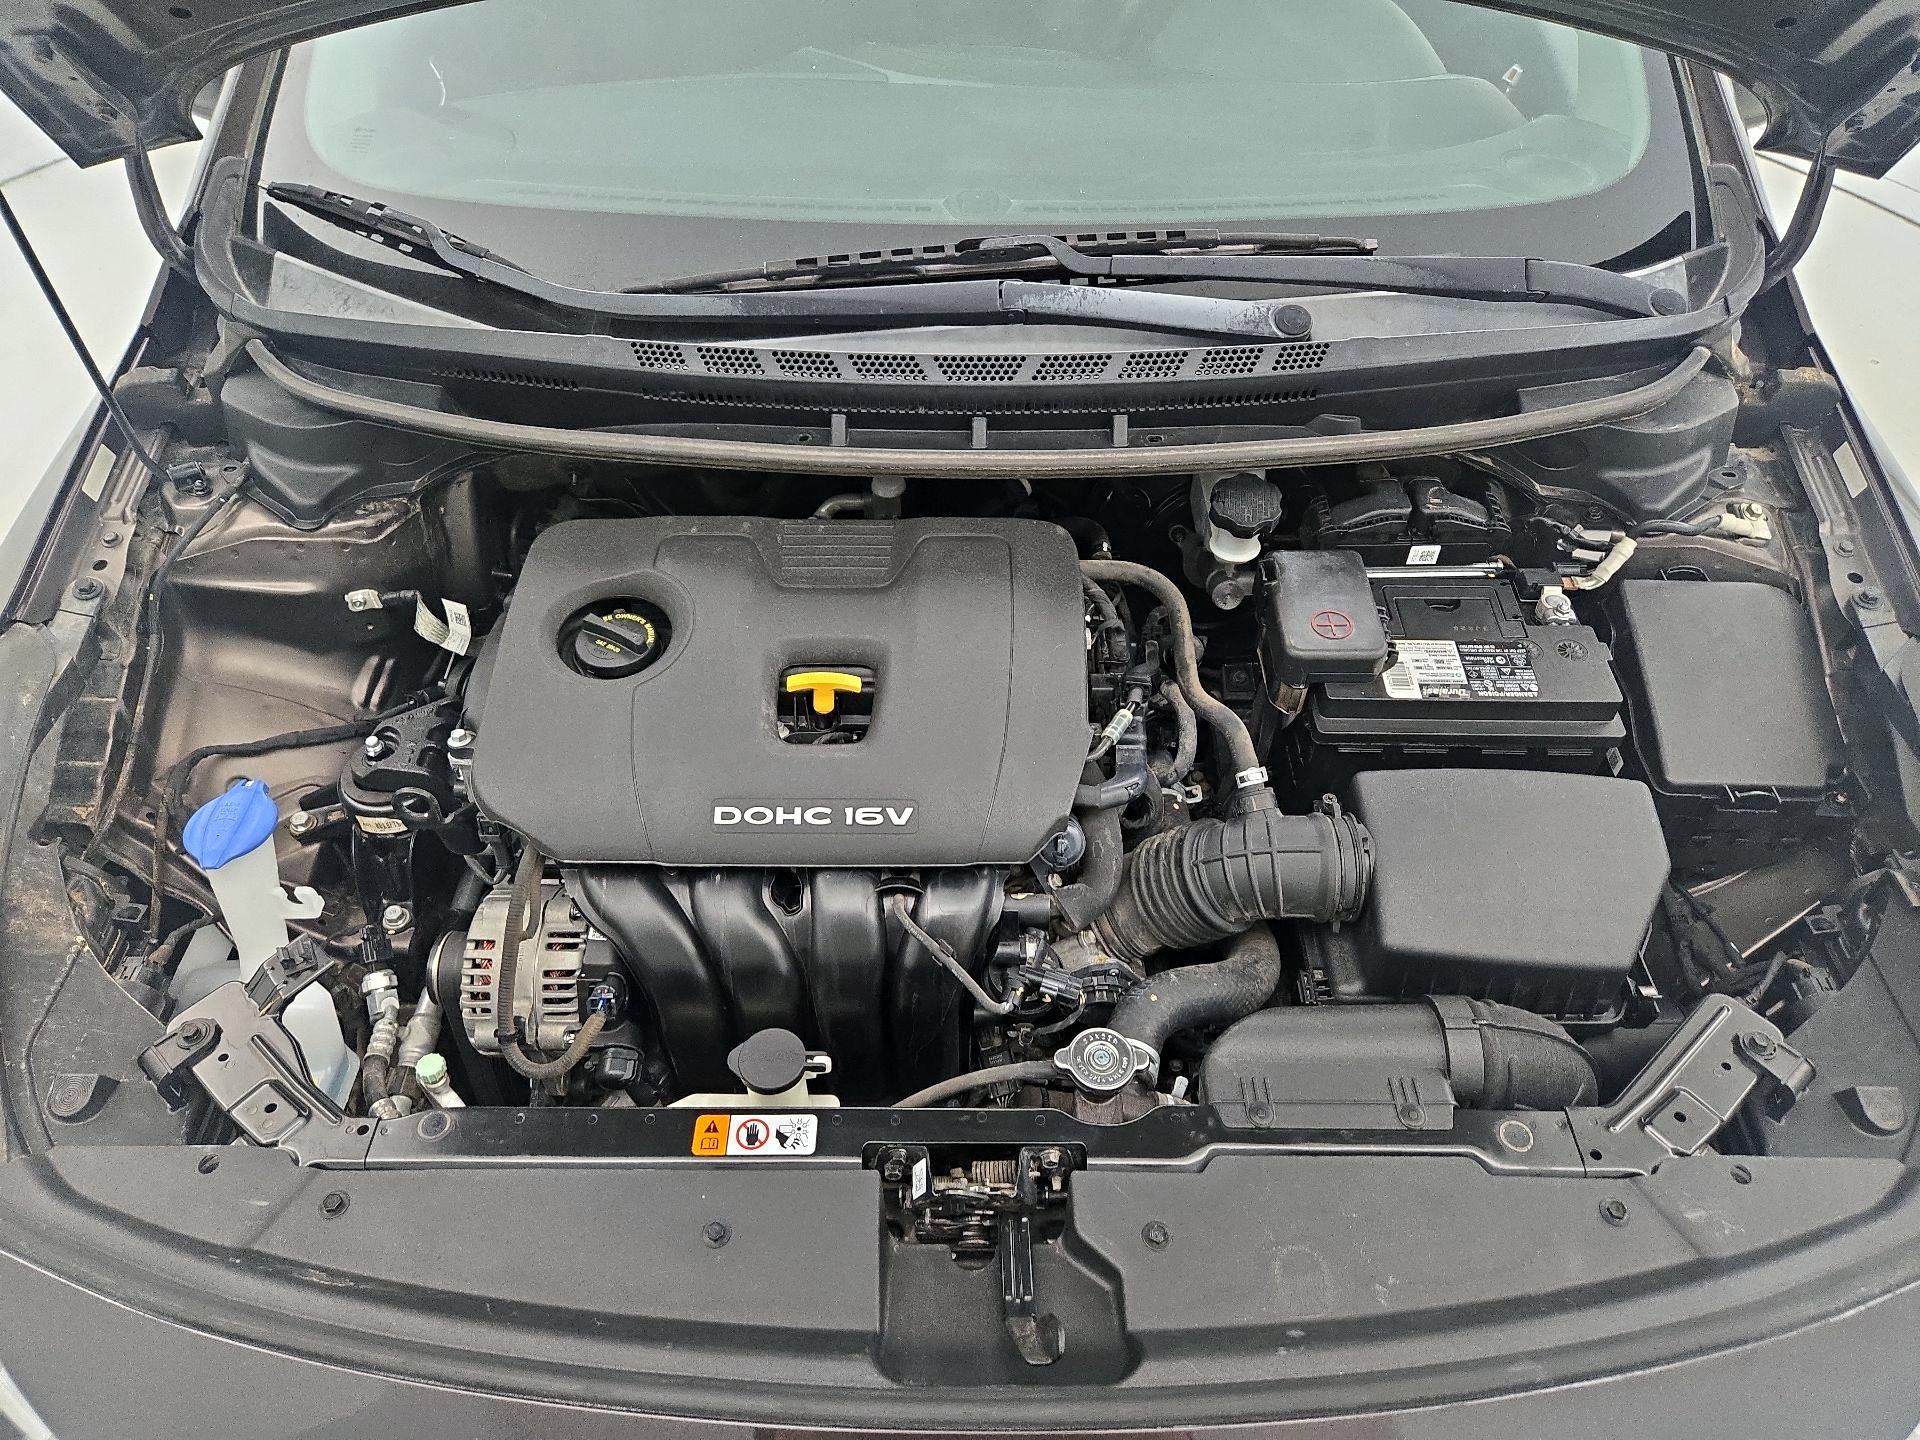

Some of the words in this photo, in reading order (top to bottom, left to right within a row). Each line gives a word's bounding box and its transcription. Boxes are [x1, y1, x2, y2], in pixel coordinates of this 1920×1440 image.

[1422, 688, 1467, 697] Duralast
[713, 806, 832, 825] DOHC
[844, 806, 914, 826] 16V
